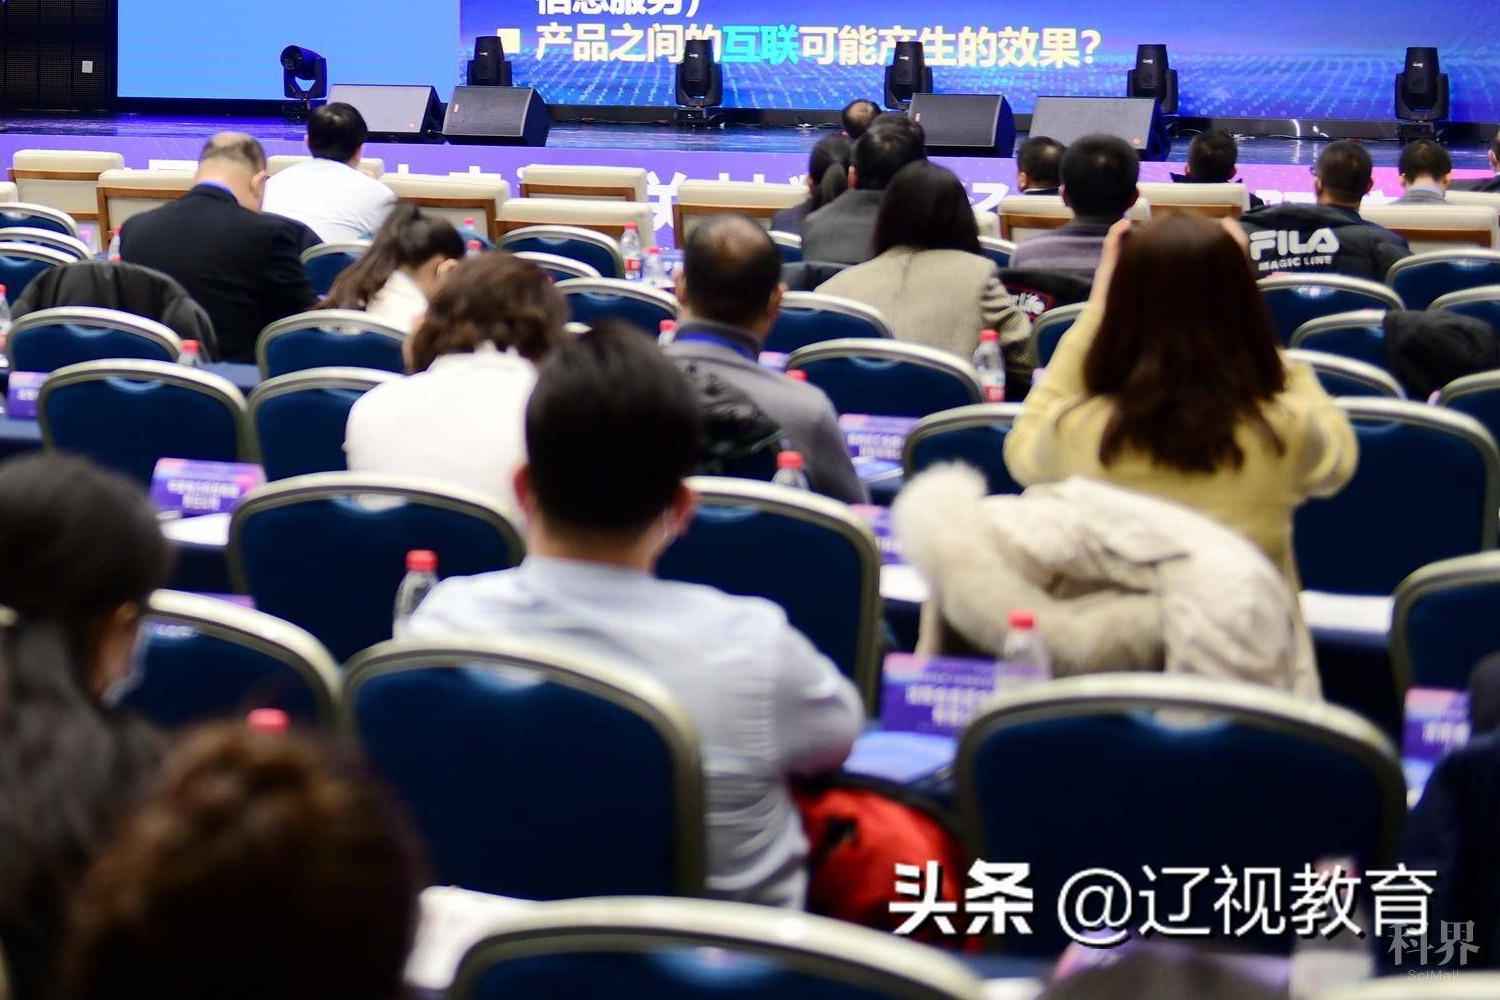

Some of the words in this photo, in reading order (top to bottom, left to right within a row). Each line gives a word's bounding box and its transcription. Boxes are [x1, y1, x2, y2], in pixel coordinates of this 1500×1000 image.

[1249, 228, 1340, 261] FILA
[1258, 256, 1302, 272] MAGIC
[1304, 255, 1333, 266] LINE
